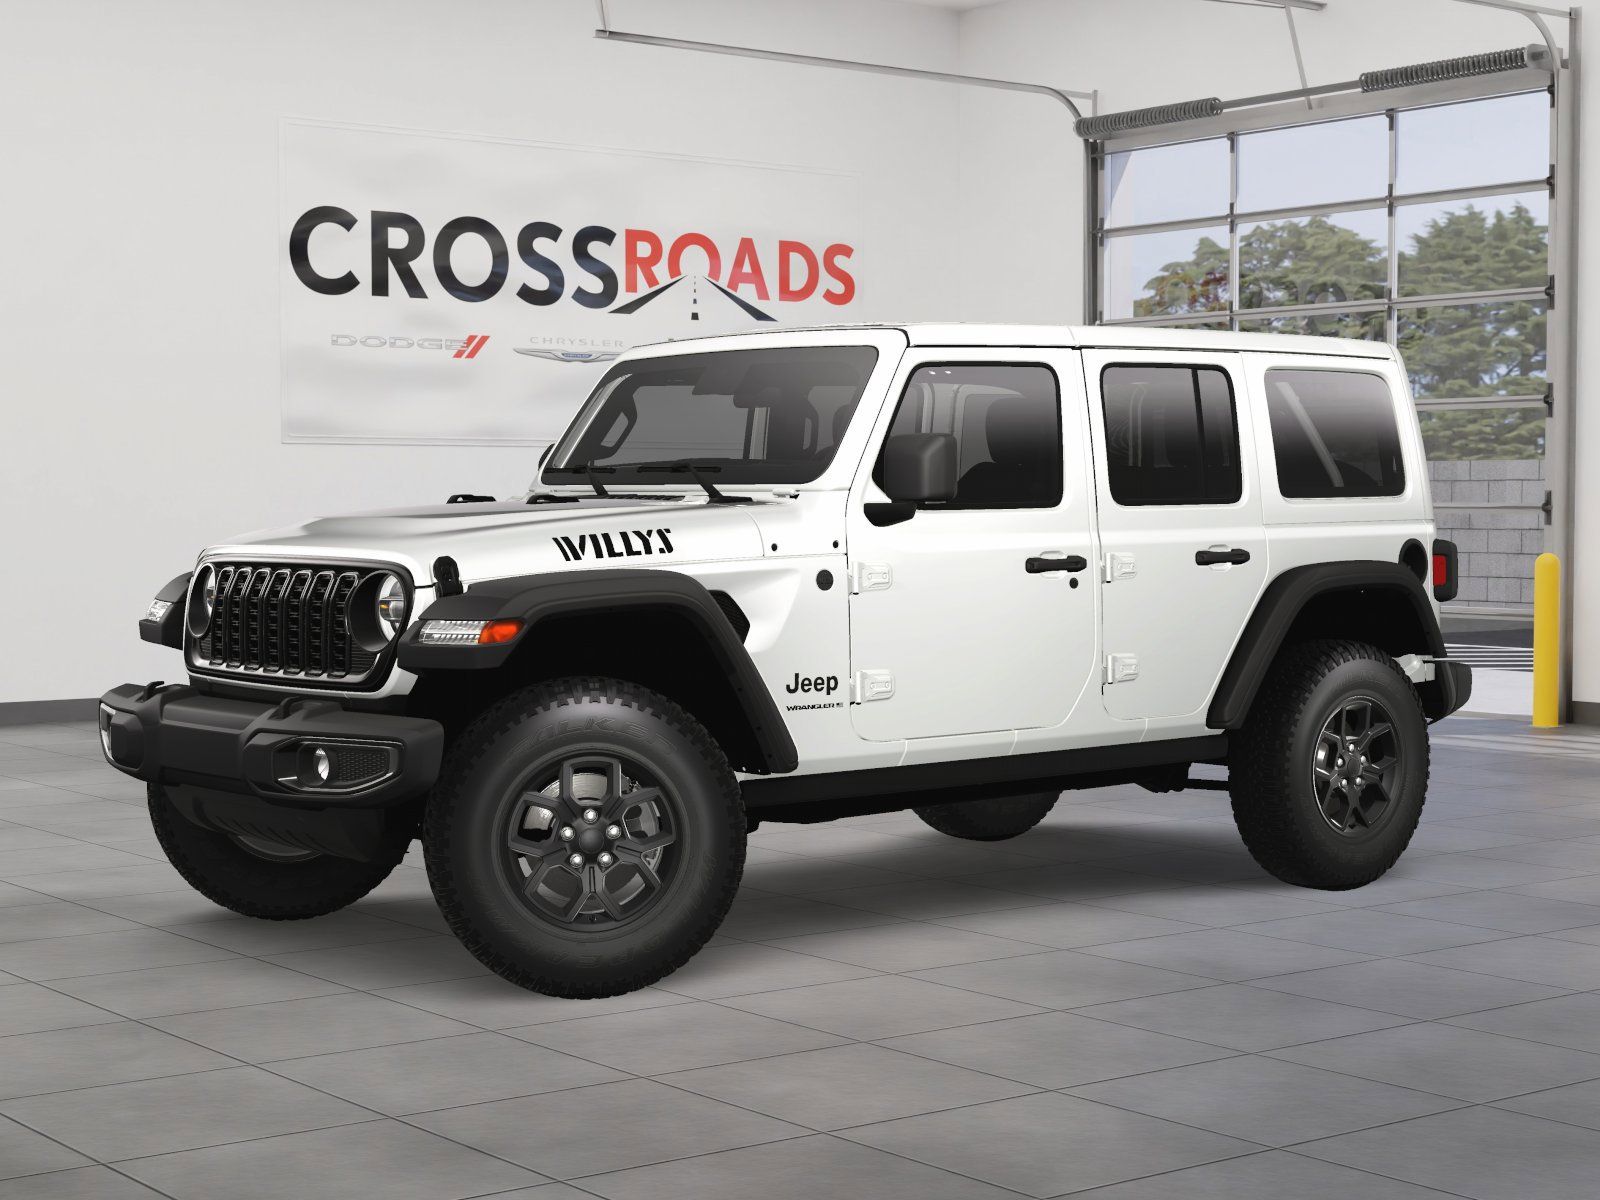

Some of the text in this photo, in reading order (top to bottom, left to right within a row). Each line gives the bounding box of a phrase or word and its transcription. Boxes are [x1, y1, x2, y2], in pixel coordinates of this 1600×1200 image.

[289, 205, 856, 309] CROSSROADS
[331, 334, 468, 350] DODGE
[529, 336, 624, 348] CHRYSLER
[552, 528, 673, 561] WILLYS
[786, 673, 838, 695] Jeep
[786, 702, 835, 711] WRANGLER
